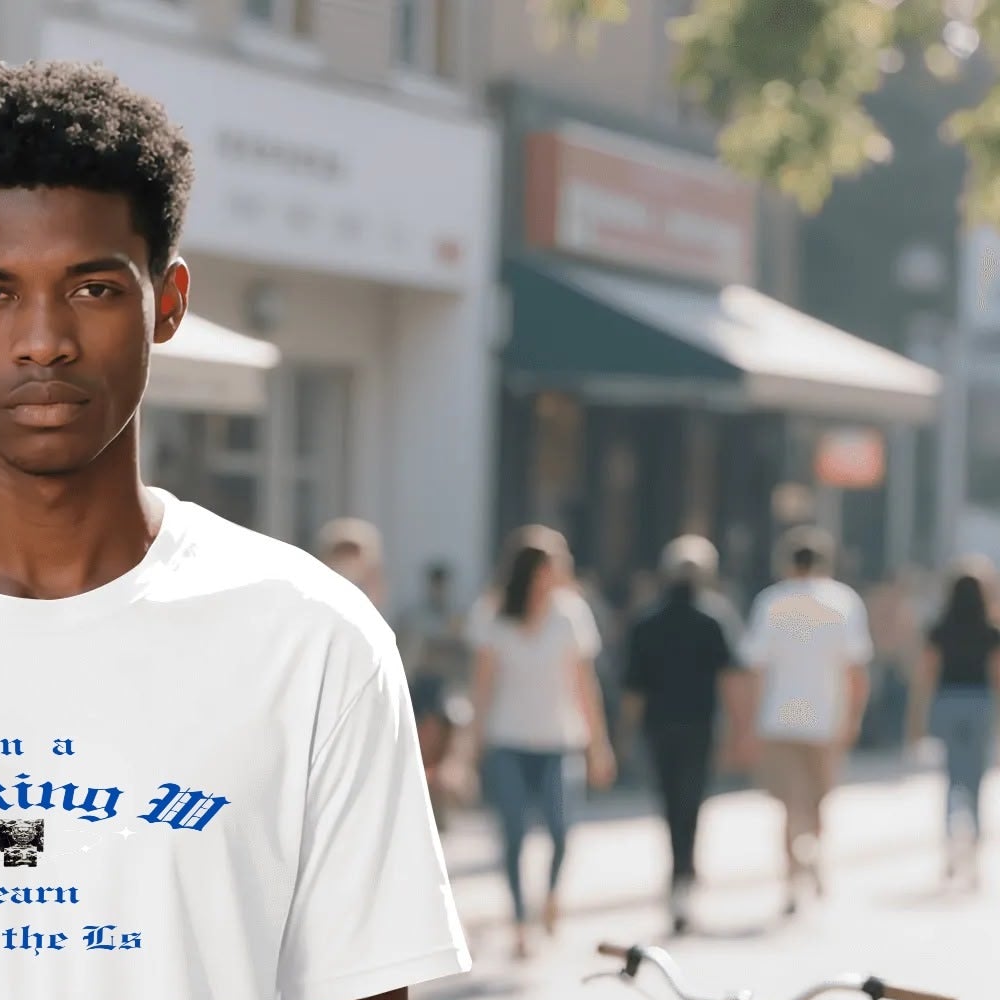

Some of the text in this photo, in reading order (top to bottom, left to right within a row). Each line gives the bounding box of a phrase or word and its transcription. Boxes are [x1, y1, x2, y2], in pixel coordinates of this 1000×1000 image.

[52, 738, 75, 756] a
[136, 782, 231, 832] W
[1, 924, 69, 956] the
[82, 924, 143, 951] Ls
